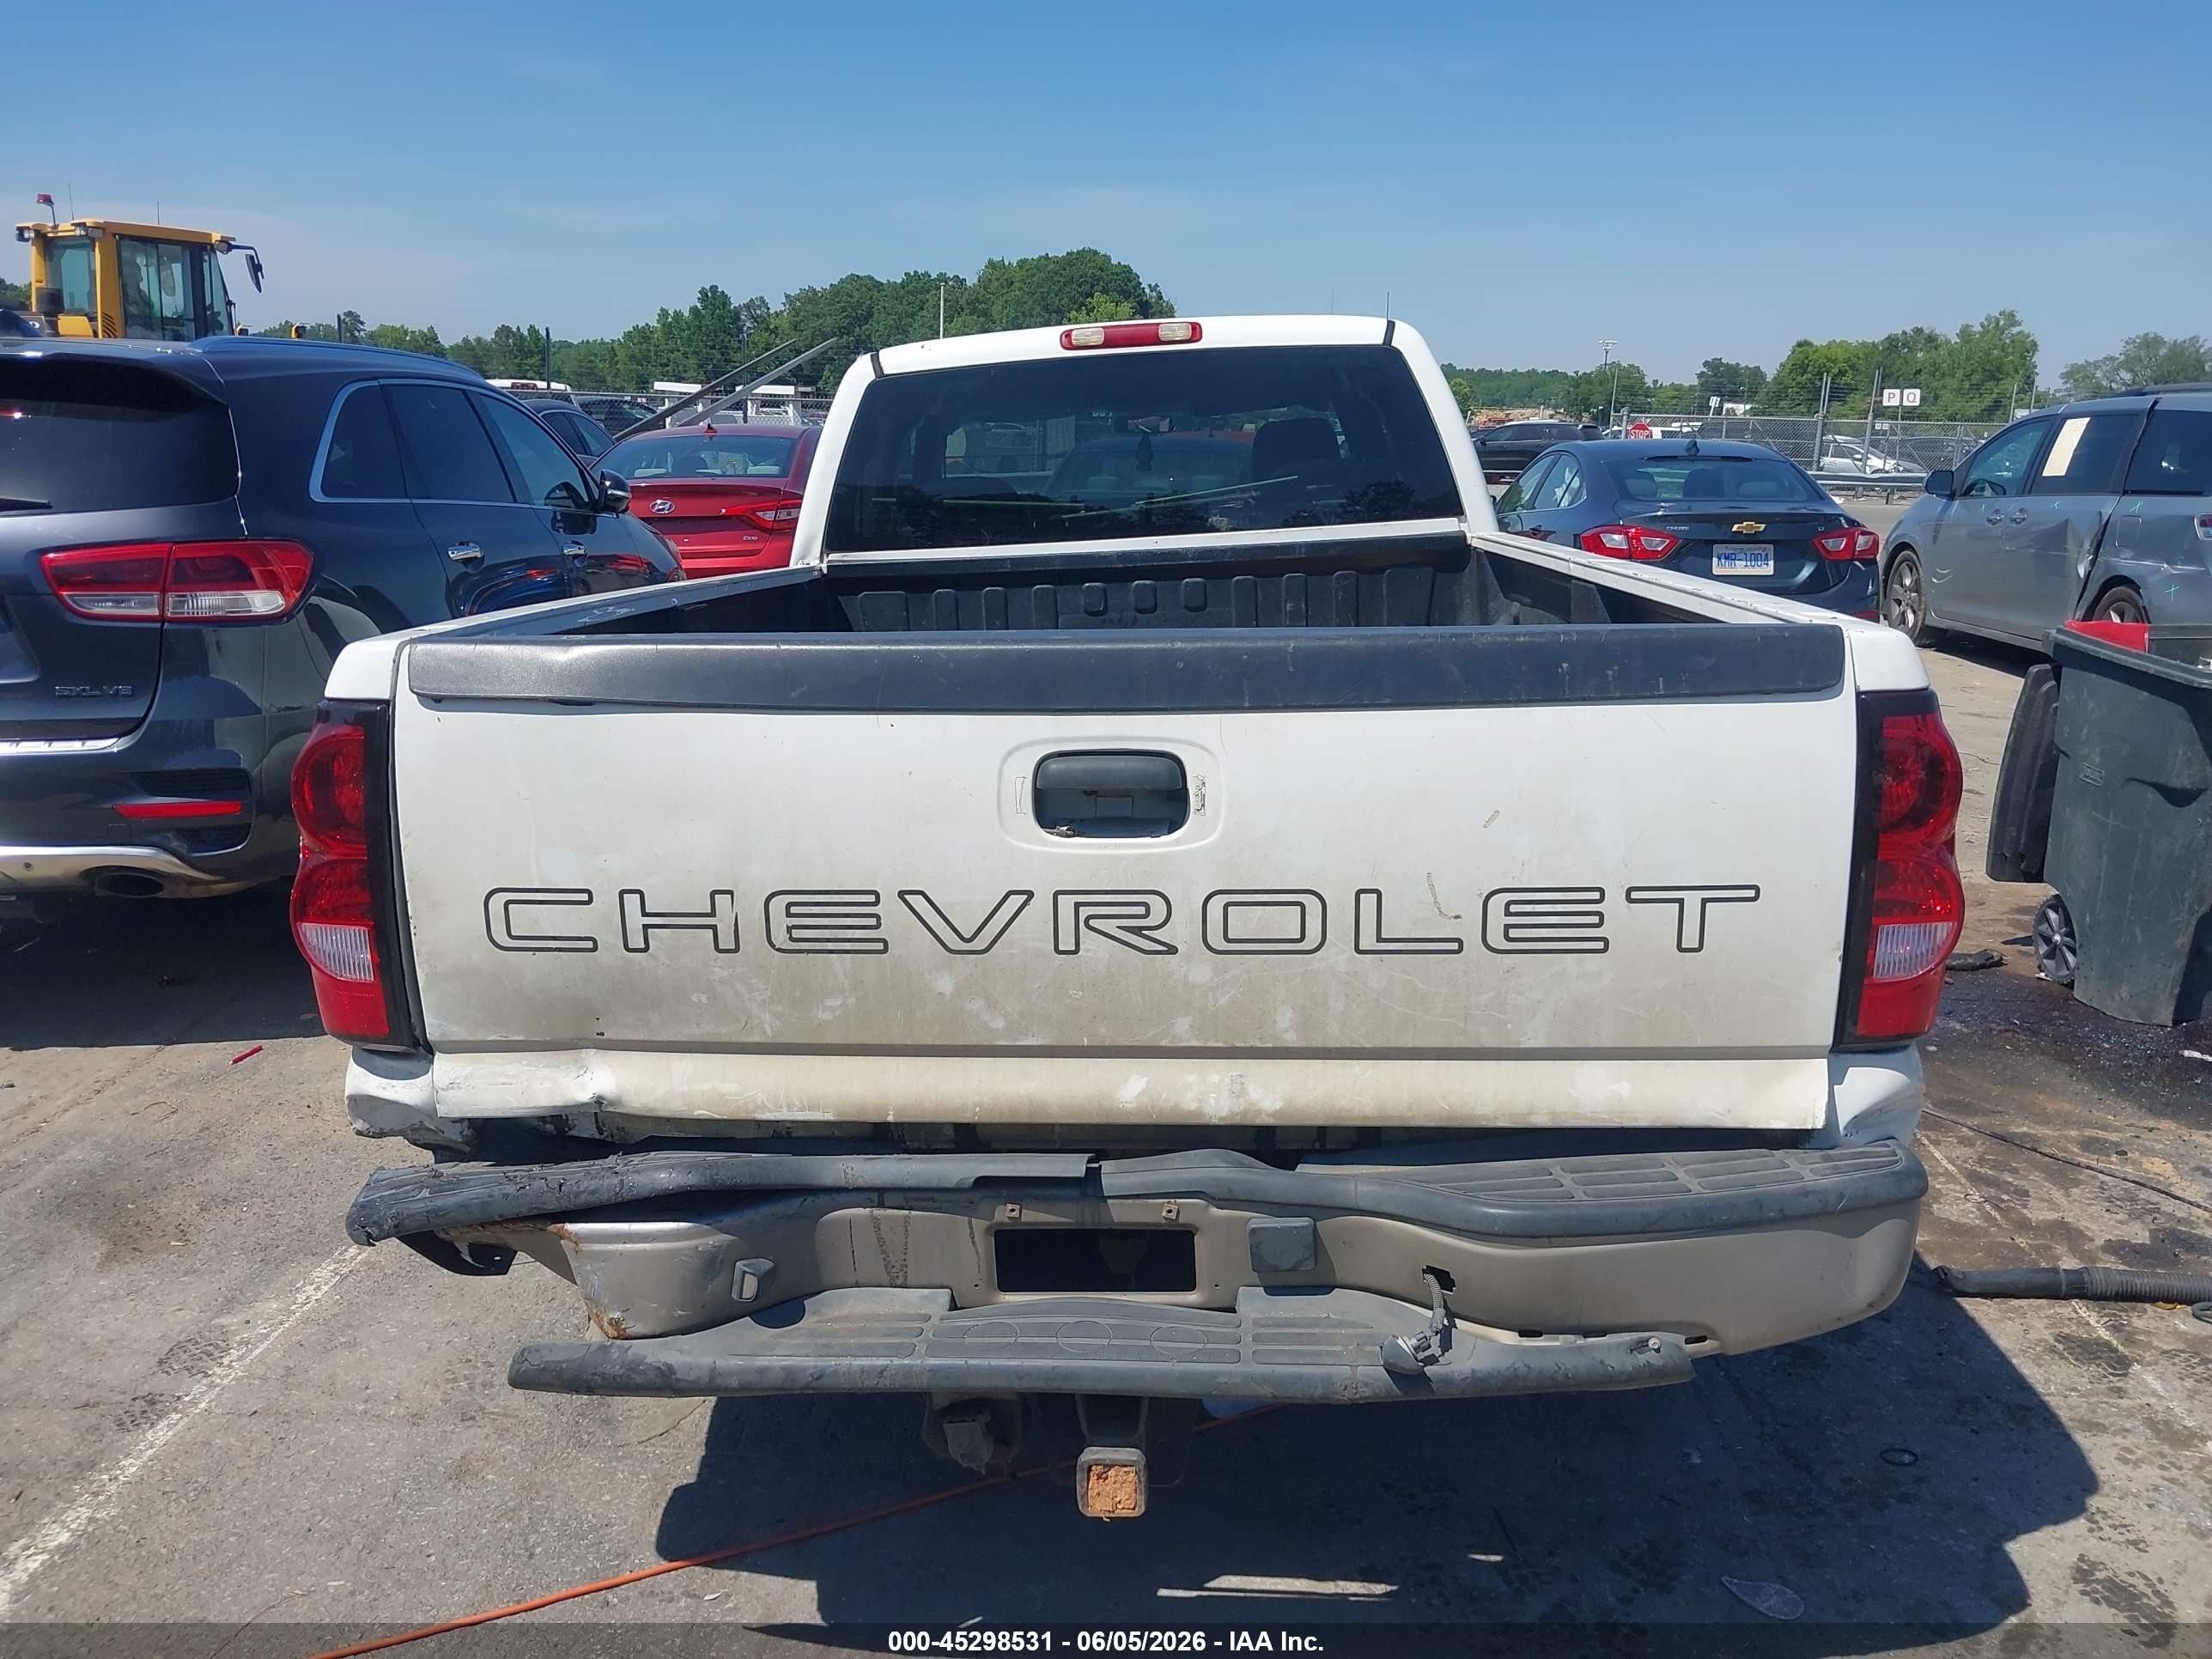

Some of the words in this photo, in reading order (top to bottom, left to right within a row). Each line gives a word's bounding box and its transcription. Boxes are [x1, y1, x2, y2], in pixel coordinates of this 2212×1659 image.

[1887, 392, 1896, 404] P
[1906, 392, 1917, 404] Q
[1631, 429, 1650, 440] STOP
[1717, 552, 1769, 568] KMR-1004
[483, 884, 1760, 956] CHEVROLET
